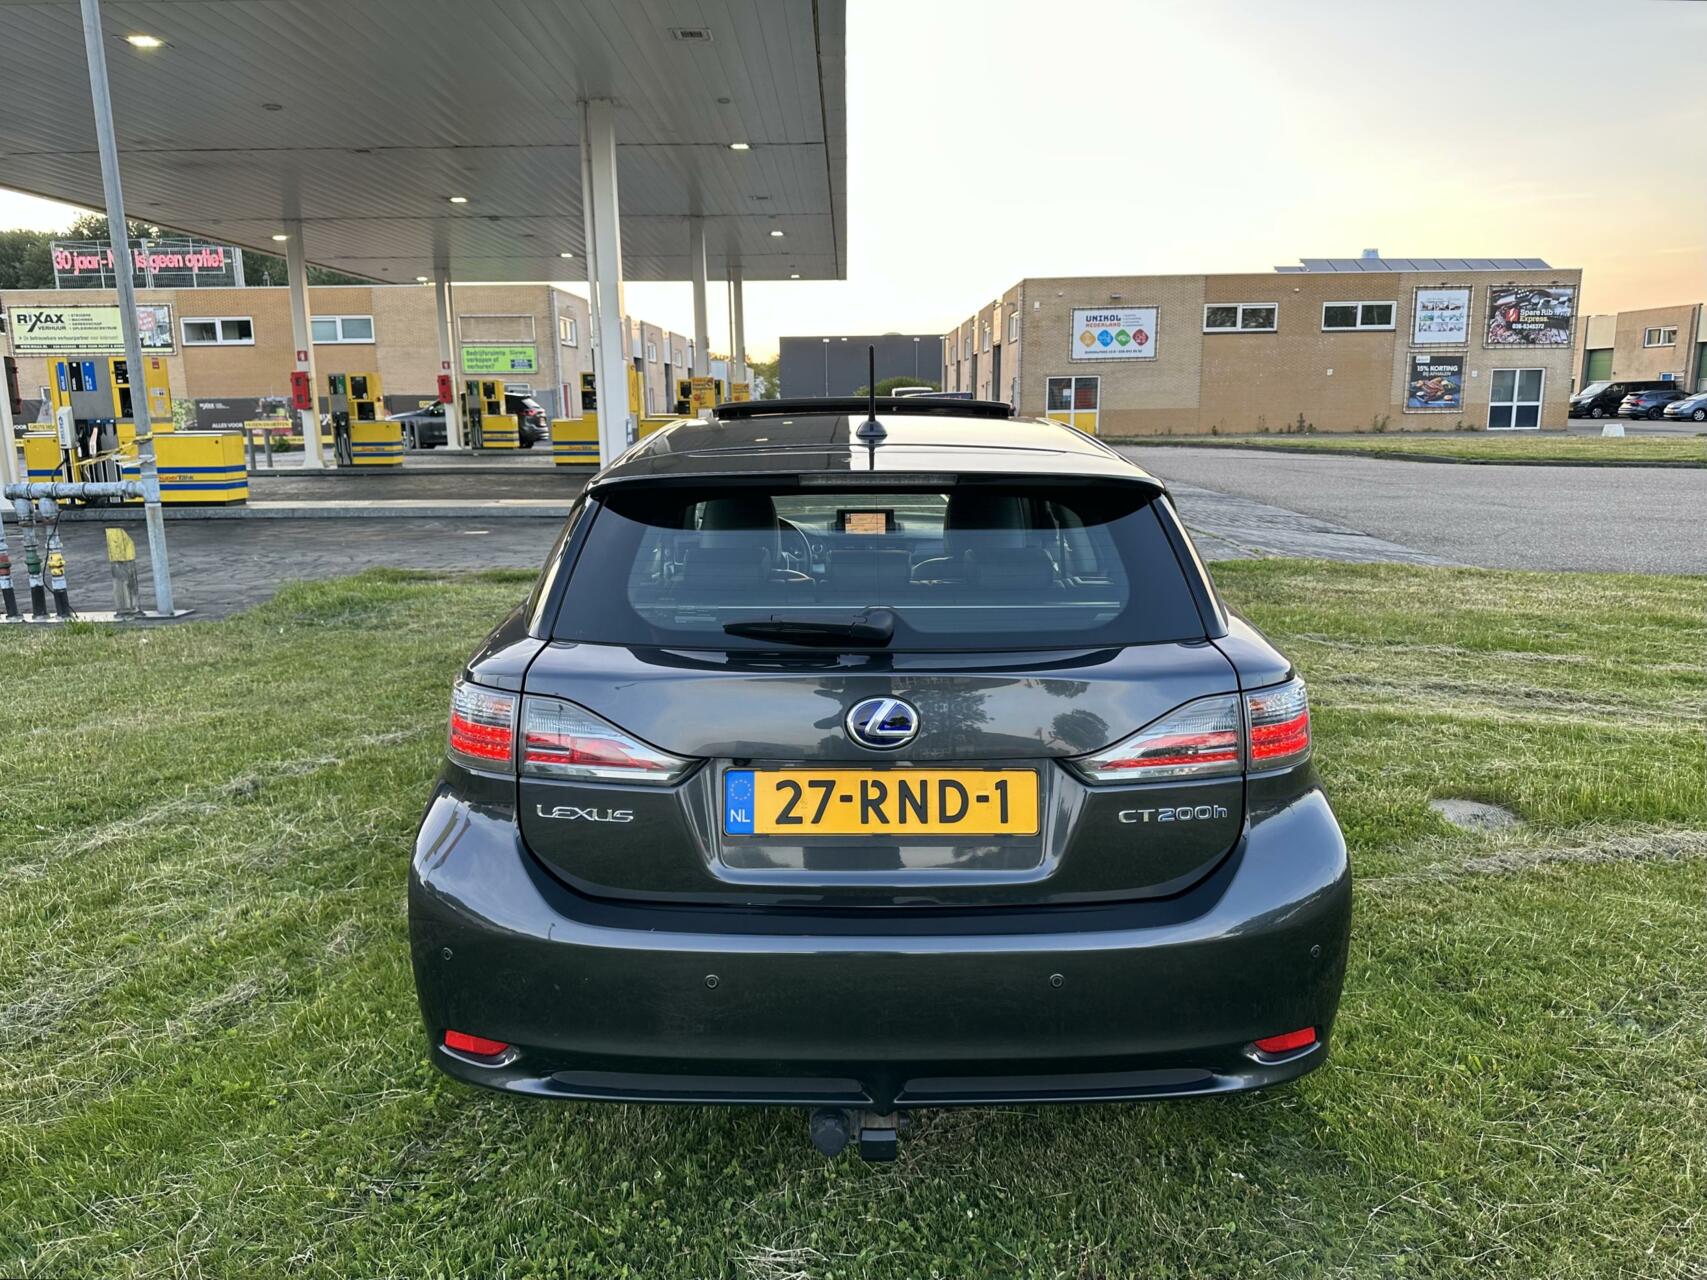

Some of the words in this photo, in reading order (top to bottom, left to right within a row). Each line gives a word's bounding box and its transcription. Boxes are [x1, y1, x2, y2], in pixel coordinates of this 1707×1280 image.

[54, 251, 71, 270] 30
[134, 248, 147, 268] is
[150, 253, 183, 274] geen
[184, 247, 224, 274] optie!
[1086, 314, 1121, 322] UNIKOL
[1520, 309, 1540, 317] Spare
[775, 779, 1009, 824] 27-RND-1
[536, 804, 634, 823] LEXUS
[730, 808, 750, 823] NL
